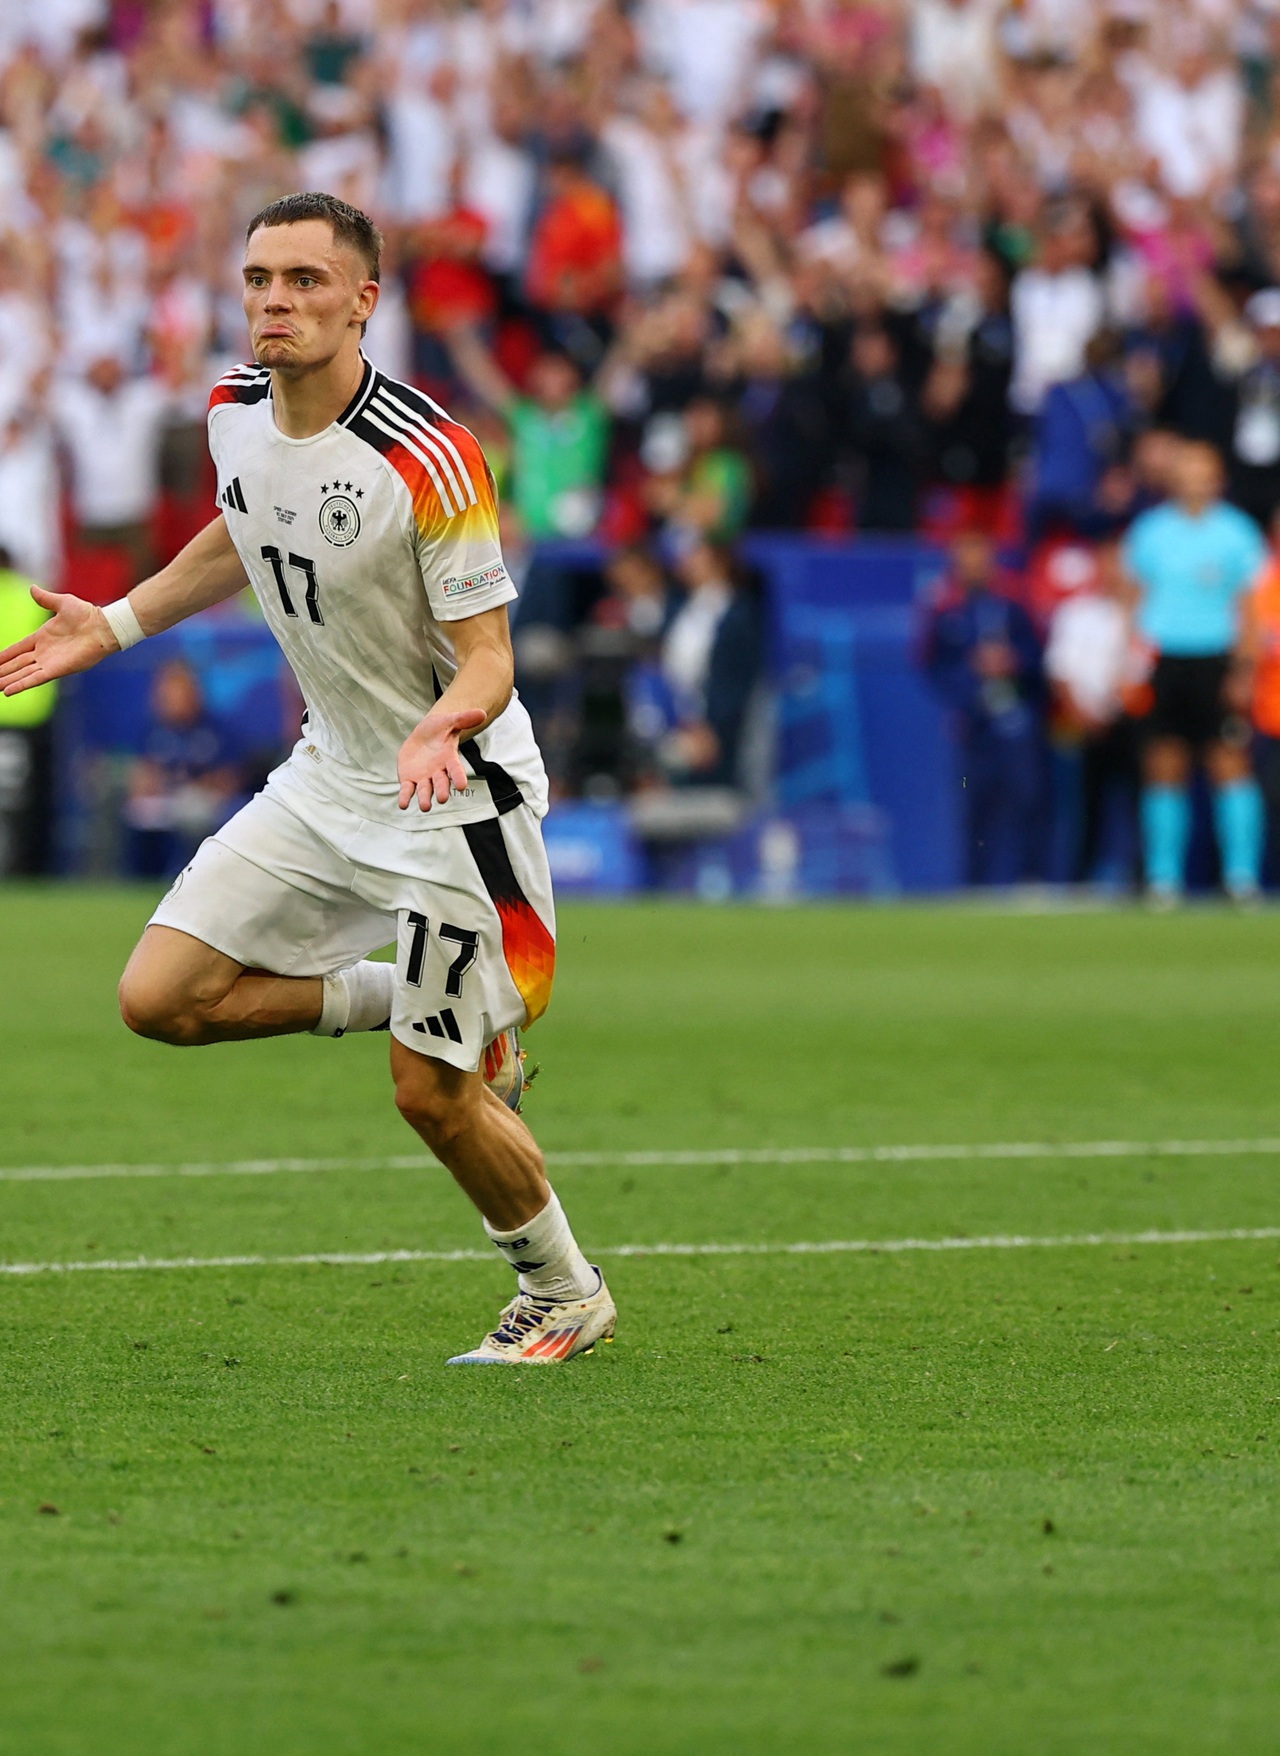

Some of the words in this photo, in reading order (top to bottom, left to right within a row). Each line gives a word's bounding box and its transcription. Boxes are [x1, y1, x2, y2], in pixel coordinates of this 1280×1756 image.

[328, 502, 352, 513] DEUTSCHER
[261, 545, 324, 626] 17
[442, 576, 457, 585] UEFA
[443, 565, 505, 594] FOUNDATION
[406, 911, 479, 999] 17
[552, 1311, 594, 1329] F50
